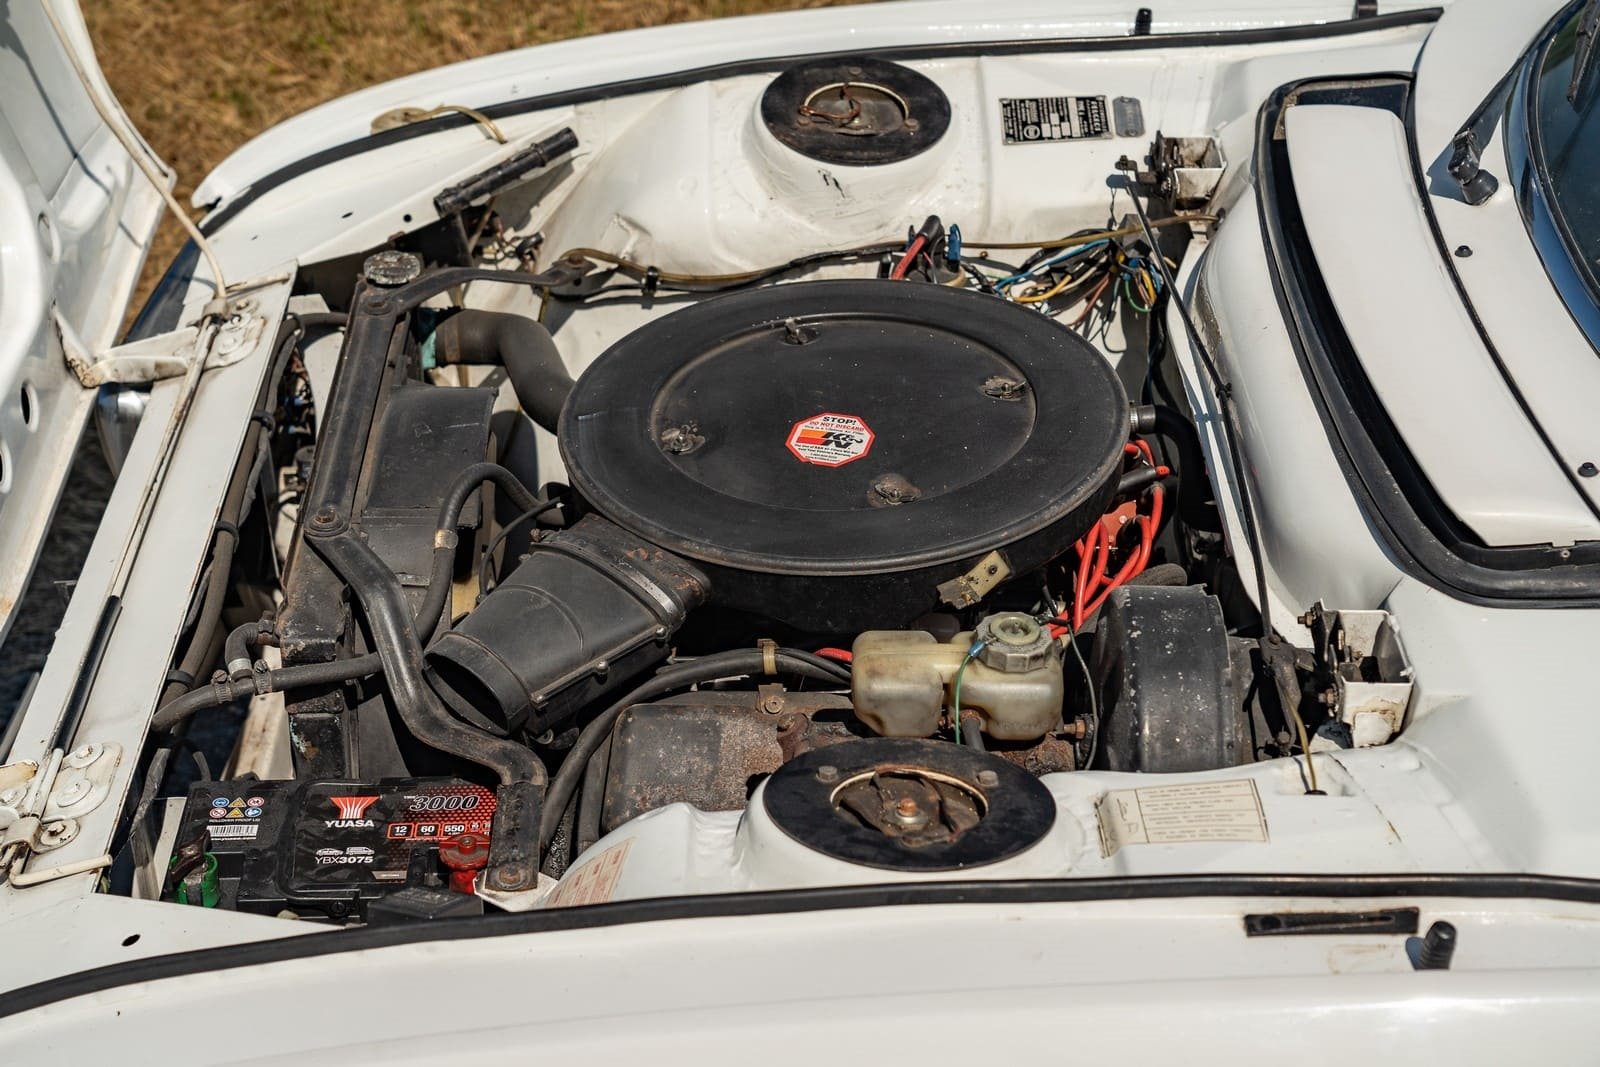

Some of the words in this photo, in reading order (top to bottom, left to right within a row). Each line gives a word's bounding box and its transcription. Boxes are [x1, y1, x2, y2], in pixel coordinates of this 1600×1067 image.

[823, 416, 857, 425] STOP!
[835, 424, 865, 432] DISCARD
[409, 794, 480, 811] 3000
[324, 819, 375, 828] YUASA
[394, 825, 407, 833] 12
[420, 825, 435, 833] 60
[444, 824, 465, 833] 550
[315, 856, 374, 864] YBX3075
